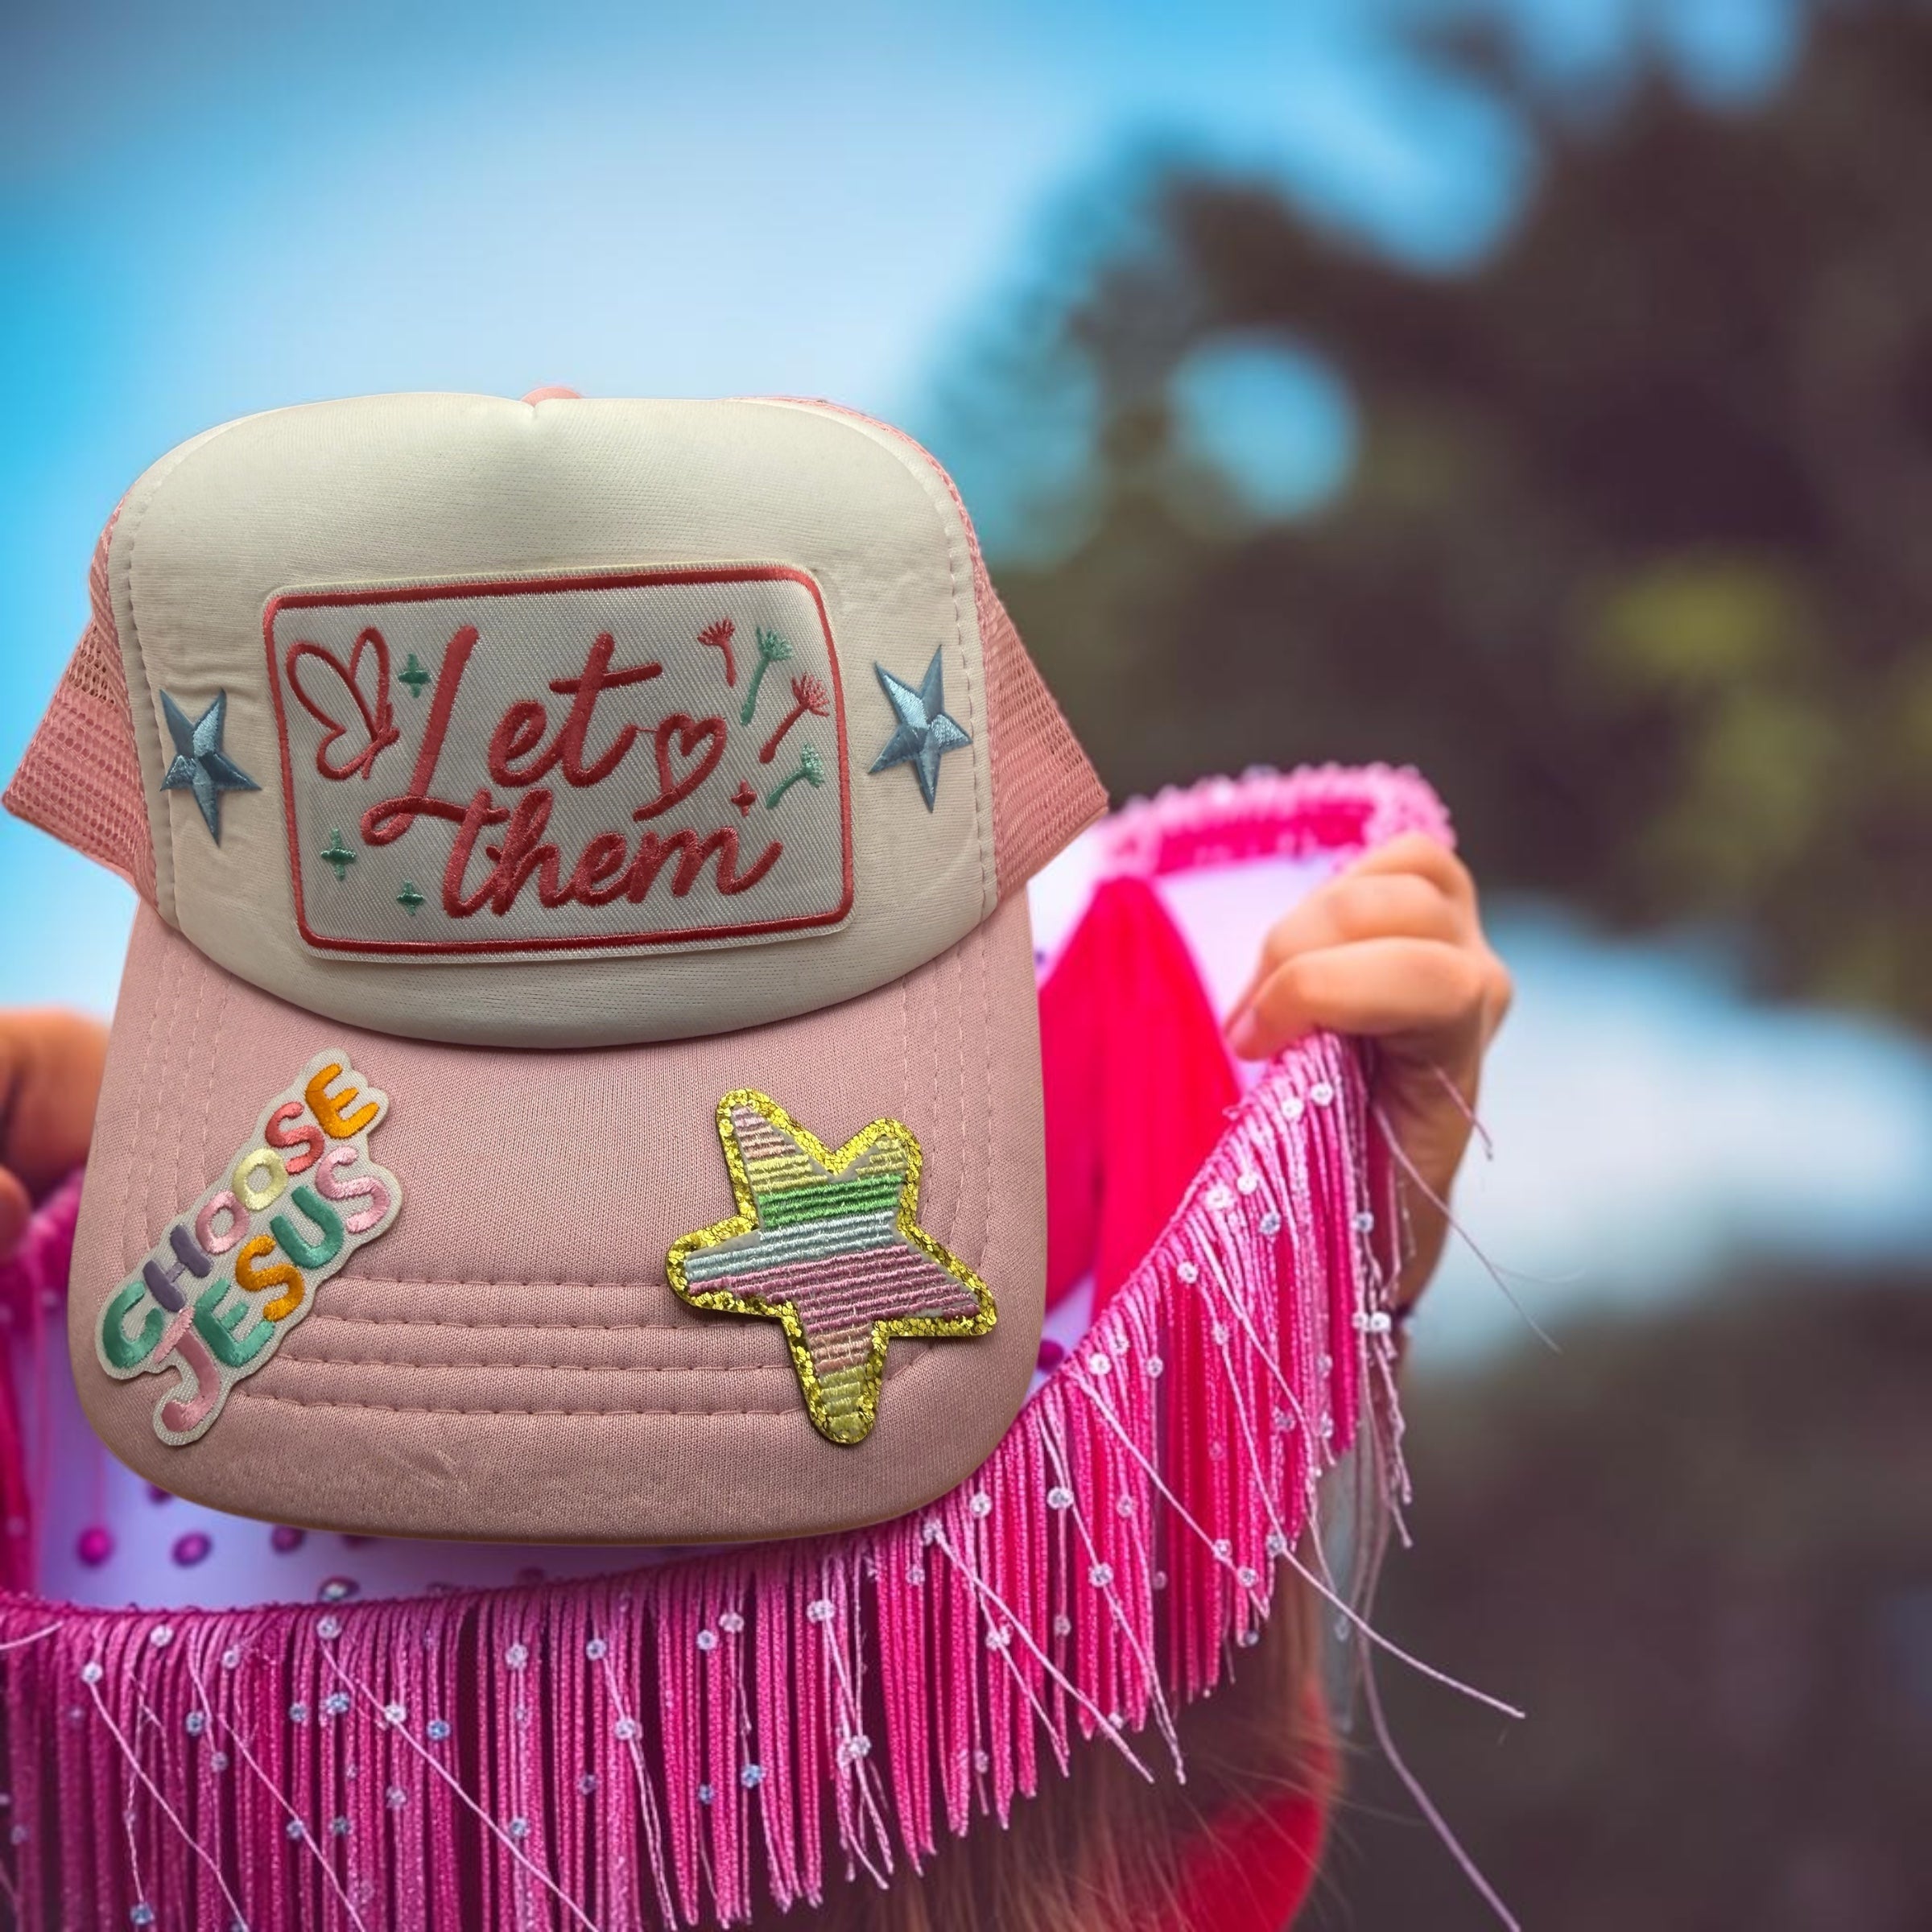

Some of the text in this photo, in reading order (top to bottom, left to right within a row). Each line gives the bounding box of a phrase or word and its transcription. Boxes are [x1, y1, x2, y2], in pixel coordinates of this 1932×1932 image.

[361, 625, 663, 846] Let
[442, 788, 783, 919] them
[102, 1063, 380, 1368] CHOOSE
[154, 1146, 390, 1431] JESUS
